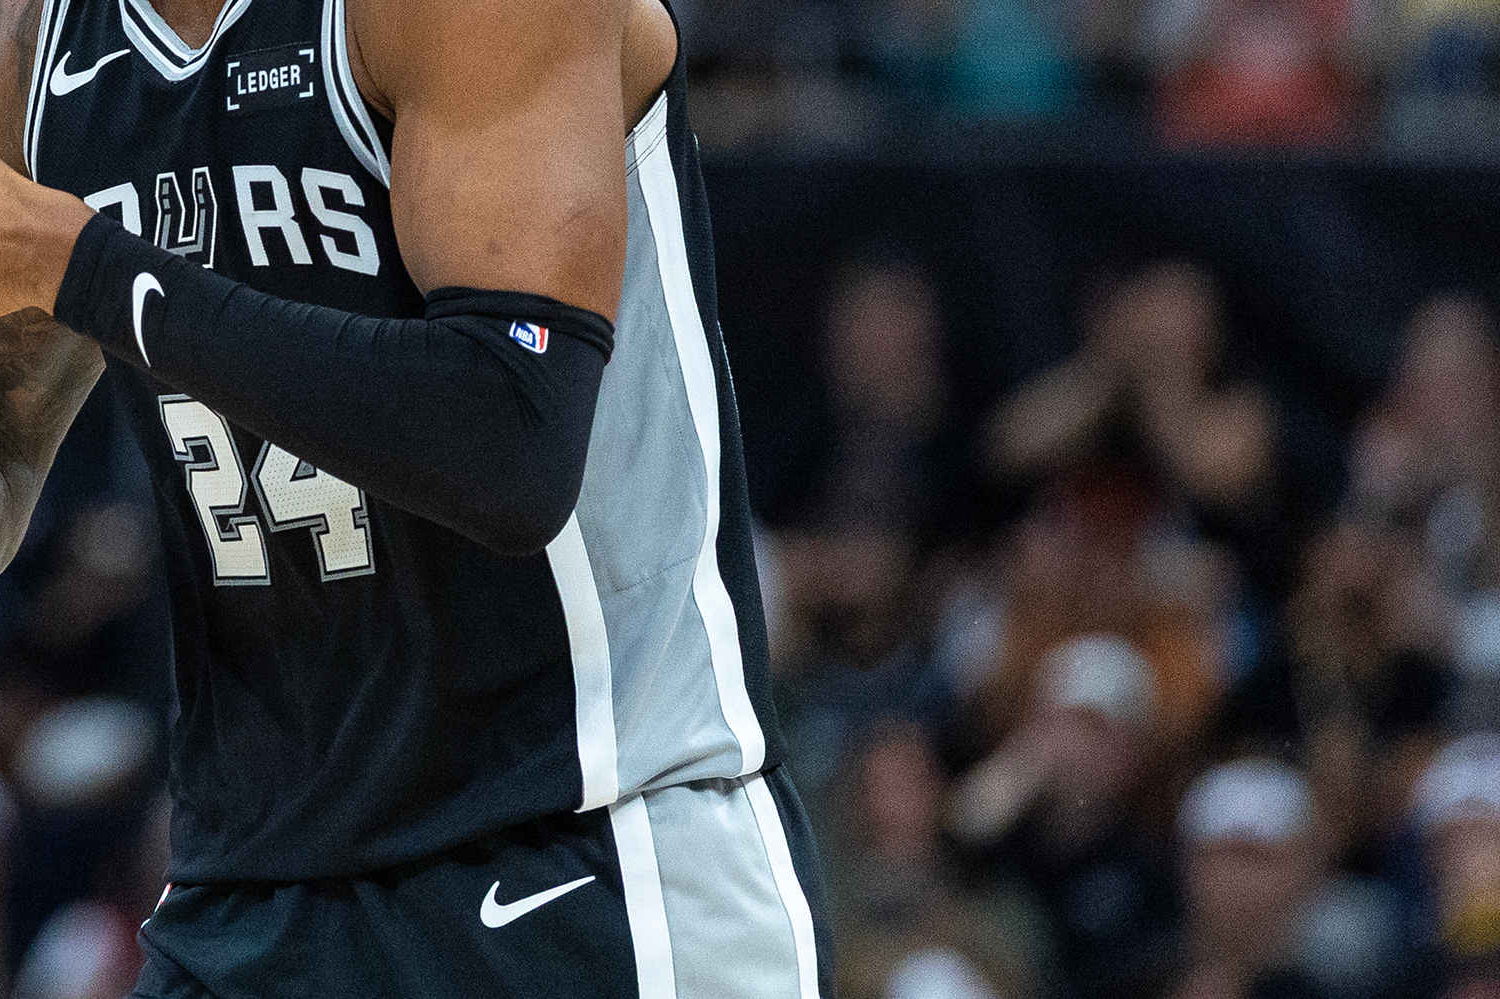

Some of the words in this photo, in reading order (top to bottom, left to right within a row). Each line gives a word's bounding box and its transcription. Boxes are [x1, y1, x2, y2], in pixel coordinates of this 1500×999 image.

[237, 64, 301, 95] LEDGER
[83, 165, 380, 277] URS
[515, 326, 534, 345] NBA
[157, 393, 376, 586] 24
